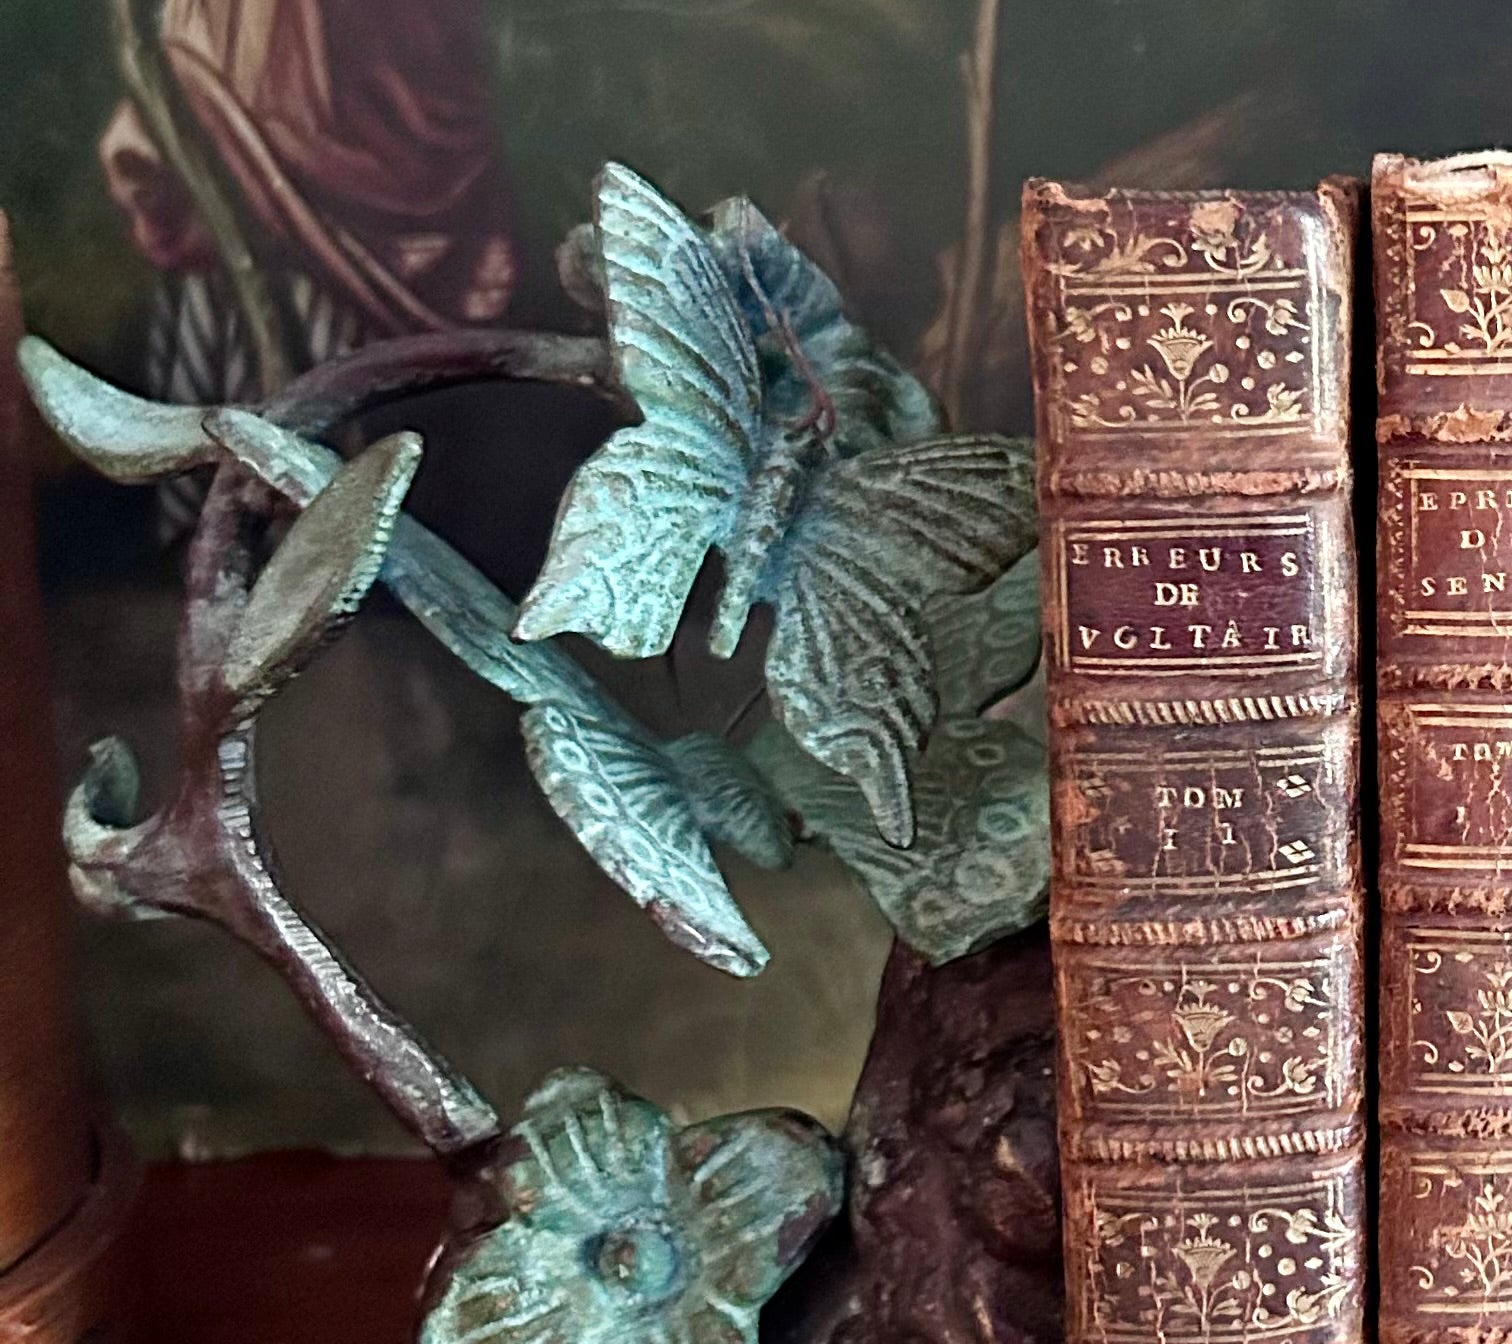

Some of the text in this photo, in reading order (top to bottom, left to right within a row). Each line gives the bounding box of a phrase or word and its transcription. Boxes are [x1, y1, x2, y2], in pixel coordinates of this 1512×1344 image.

[1071, 543, 1300, 577] ERREURS
[1154, 582, 1200, 607] DE
[1156, 786, 1245, 809] TOM
